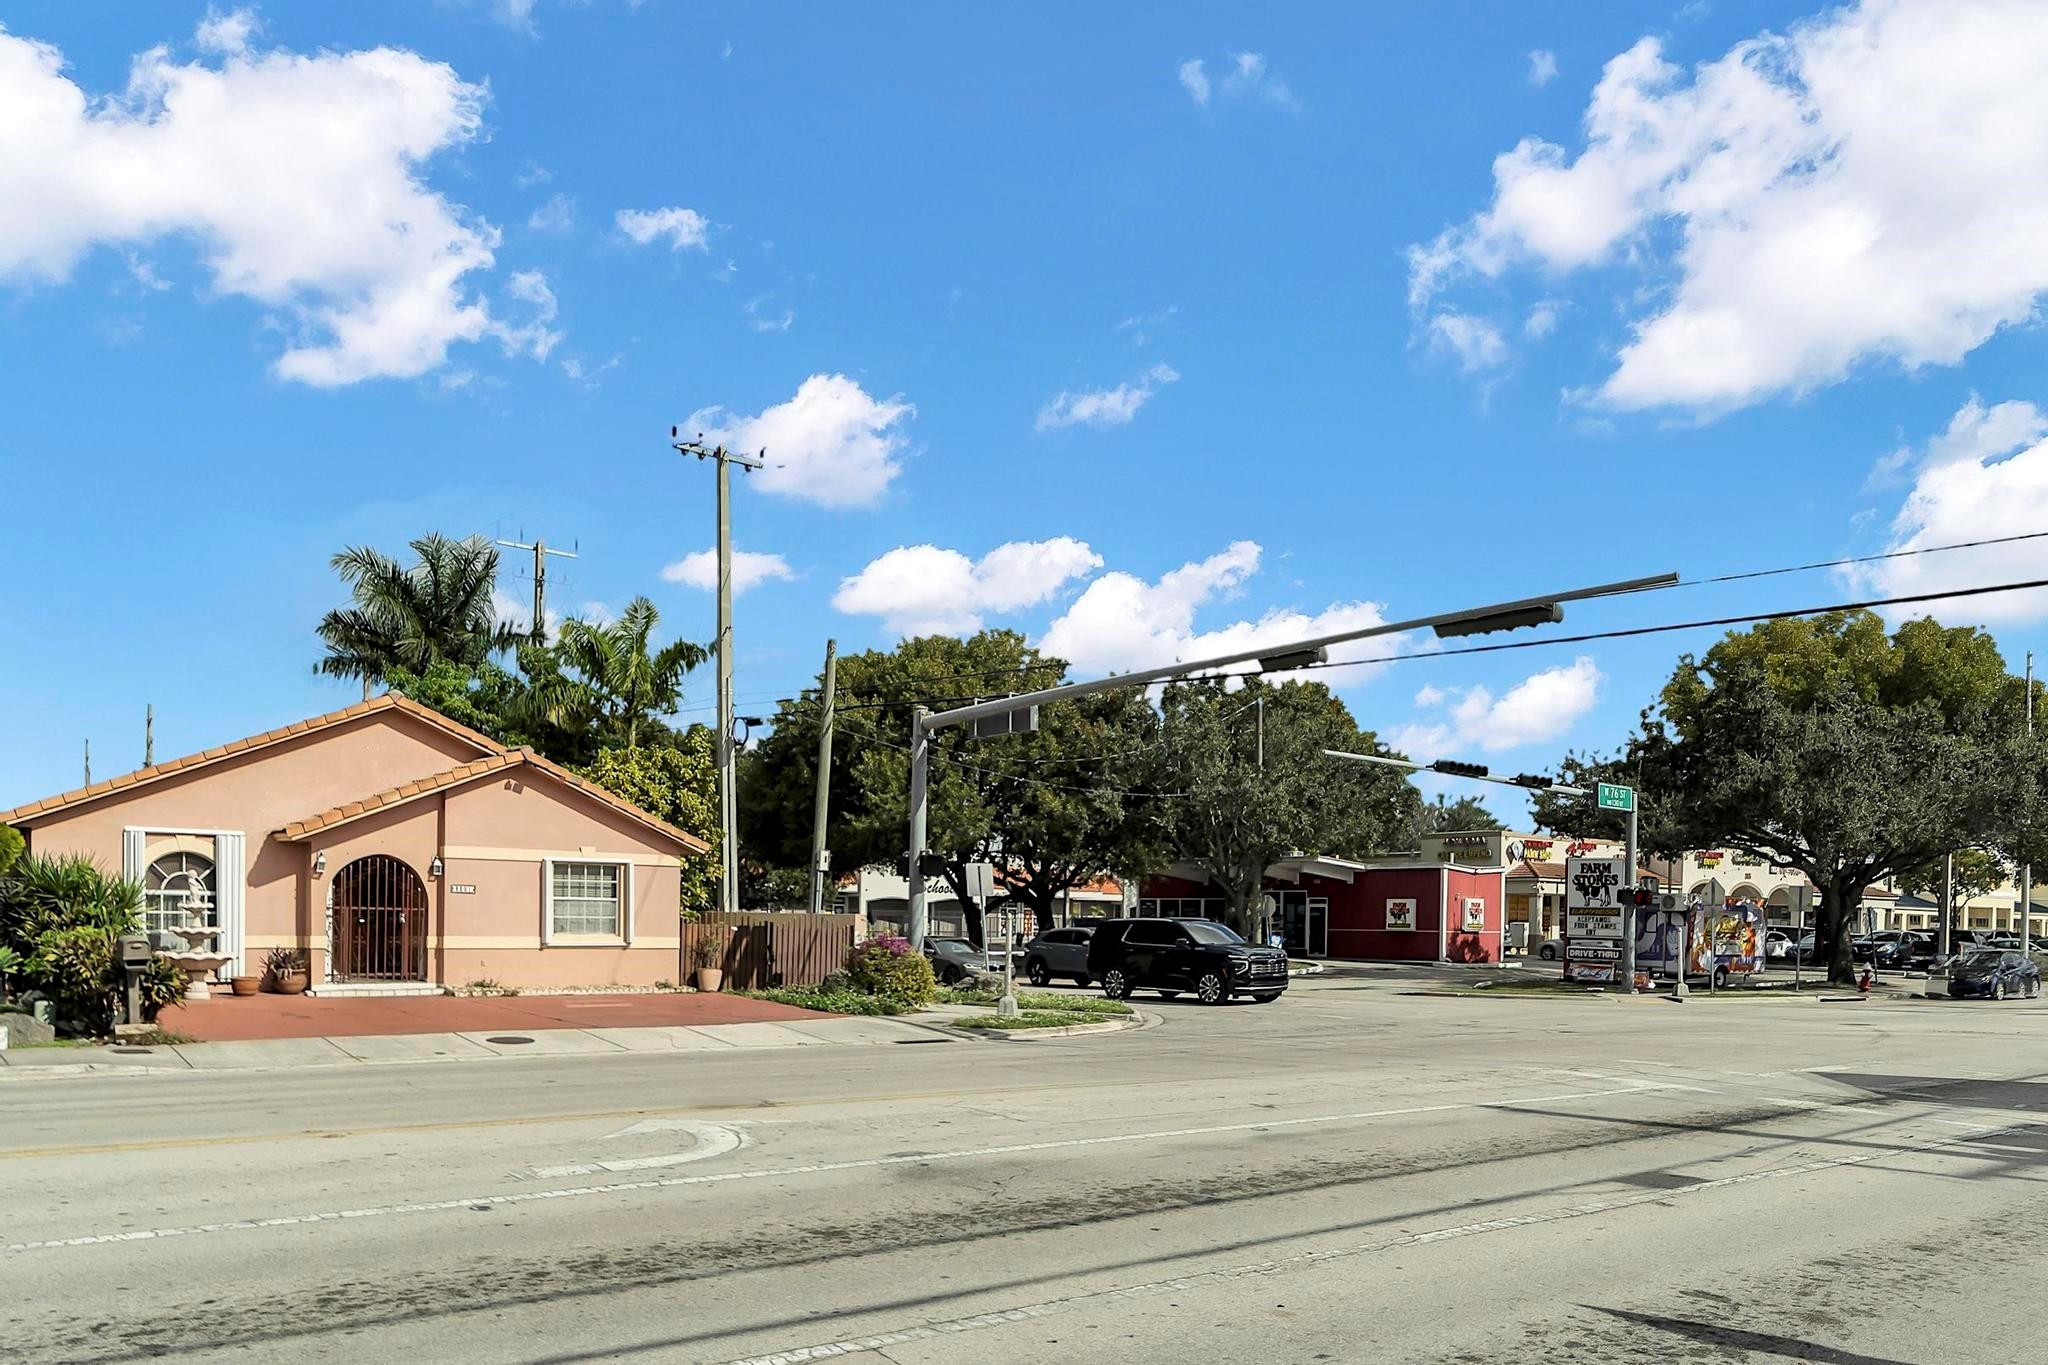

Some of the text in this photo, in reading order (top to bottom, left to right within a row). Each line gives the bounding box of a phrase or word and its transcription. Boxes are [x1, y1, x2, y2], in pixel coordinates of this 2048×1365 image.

[1604, 787, 1626, 799] W 76 ST
[1580, 862, 1612, 874] FARM
[1572, 874, 1619, 886] STORES
[1592, 922, 1617, 930] STAMPS
[1569, 949, 1620, 958] DRIVE-THRU
